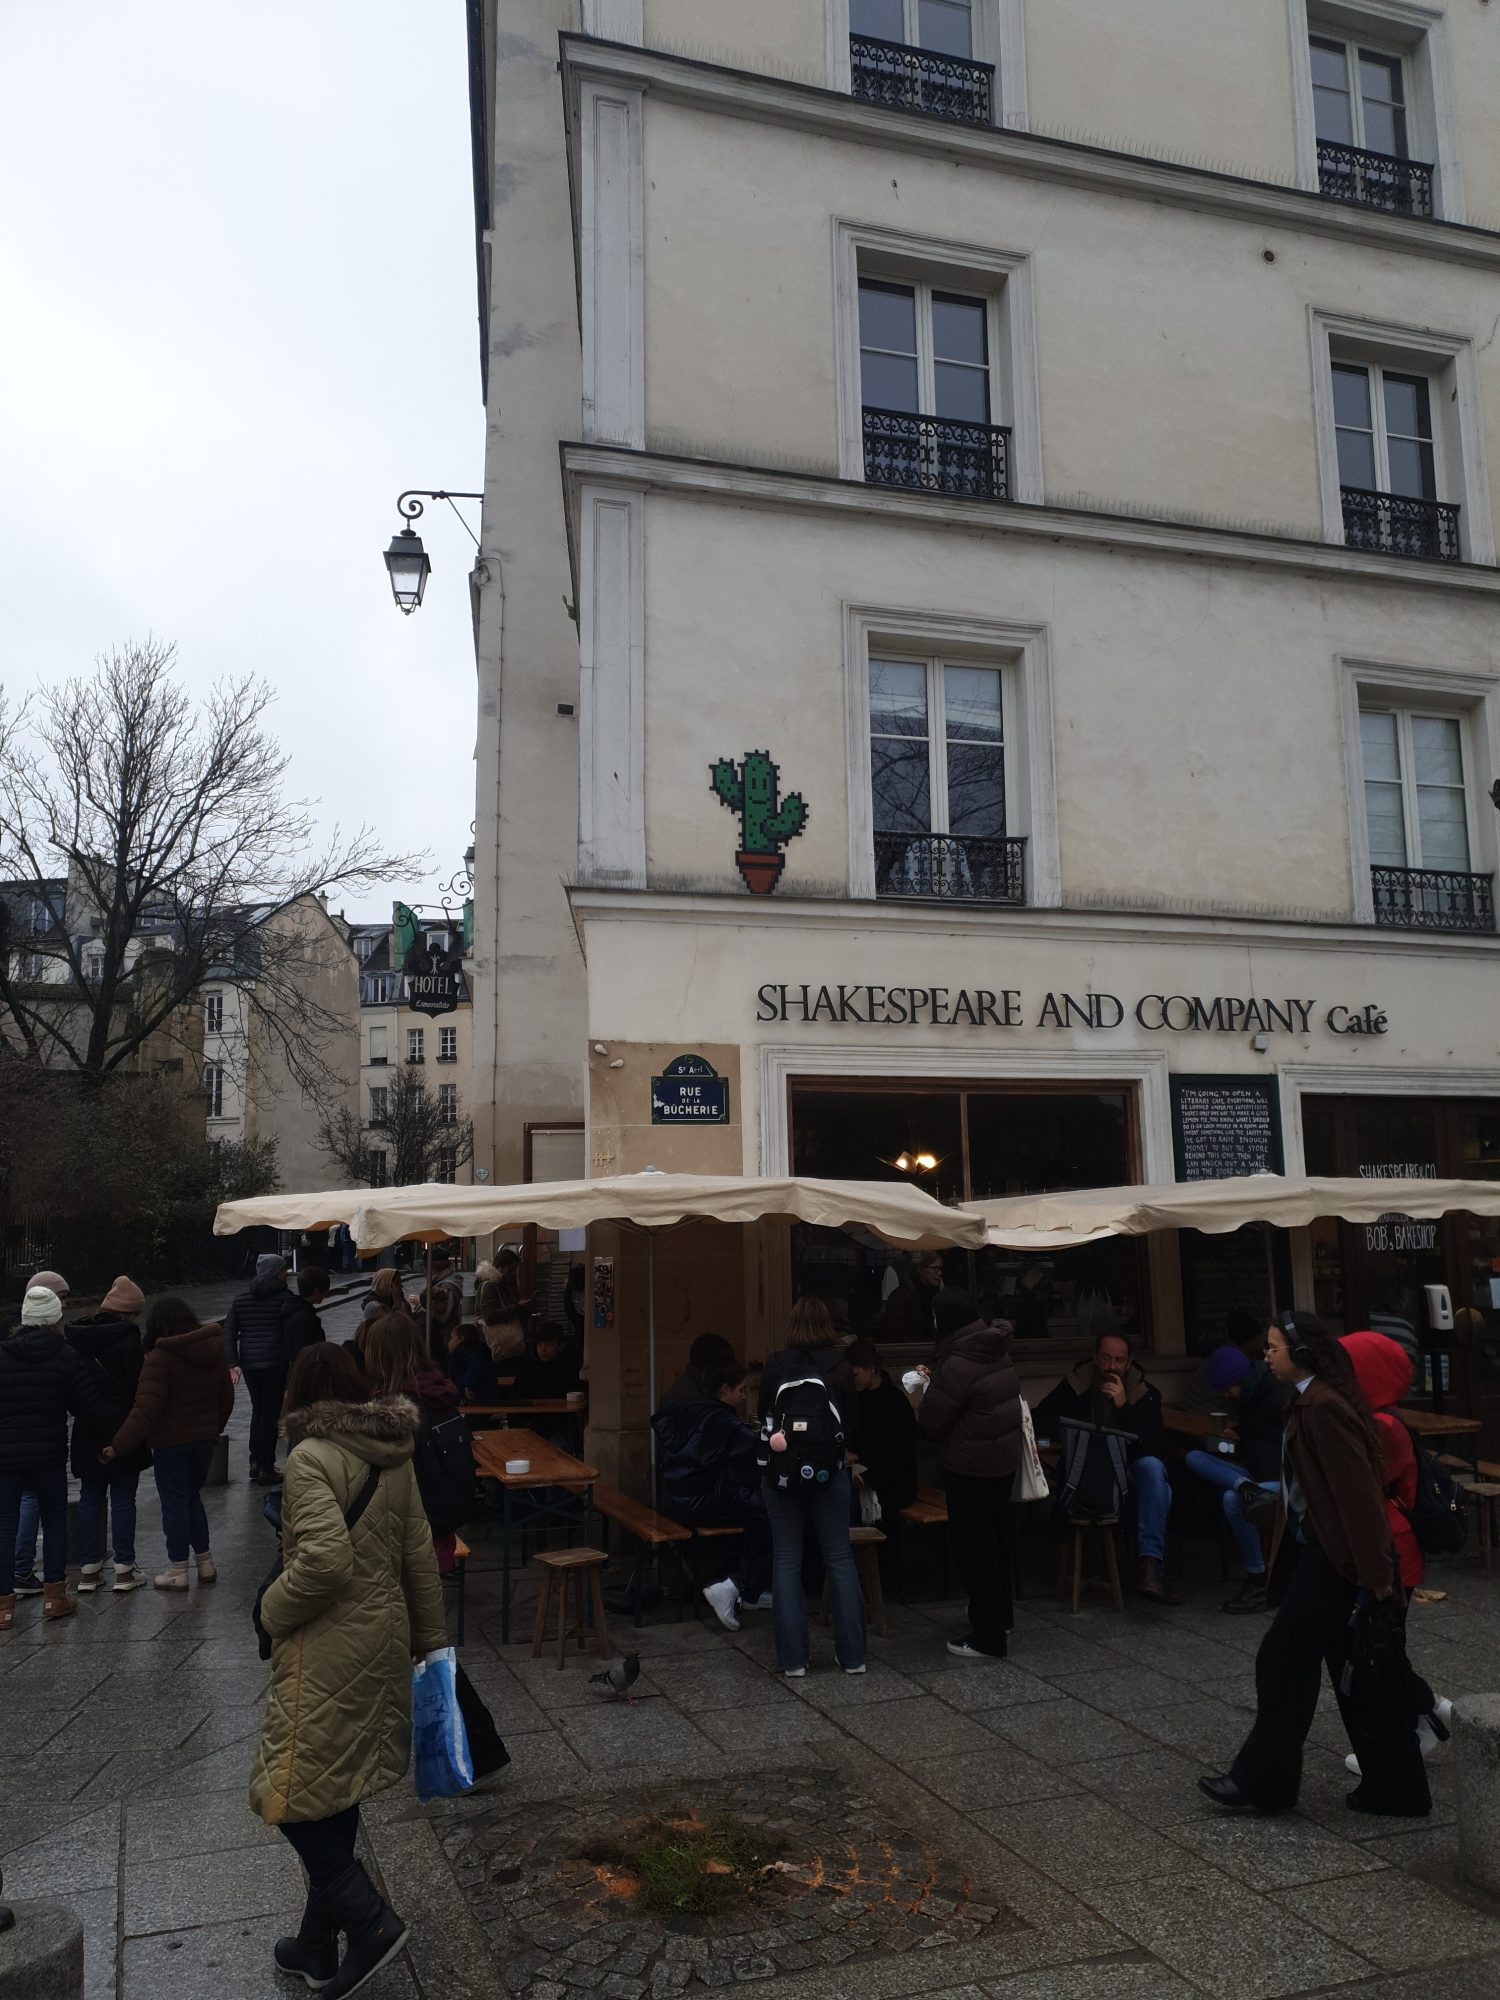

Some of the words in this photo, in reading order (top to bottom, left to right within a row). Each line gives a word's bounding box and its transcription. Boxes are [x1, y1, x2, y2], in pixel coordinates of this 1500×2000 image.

[414, 976, 453, 995] HOTEL
[415, 999, 451, 1009] Esmeralda
[756, 983, 1024, 1027] SHAKESPEARE
[1035, 992, 1124, 1030] AND
[1135, 994, 1317, 1034] COMPANY
[1325, 1004, 1389, 1035] Café
[679, 1087, 702, 1097] RUE
[1198, 1090, 1219, 1098] GOING
[663, 1103, 718, 1115] BÛCHERIE
[1195, 1136, 1207, 1144] GOT
[1208, 1136, 1217, 1144] TO
[1218, 1136, 1234, 1144] RAISE
[1239, 1136, 1268, 1144] ENOUGH
[1186, 1144, 1208, 1153] MONEY
[1212, 1144, 1219, 1153] TO
[1221, 1144, 1233, 1153] BUY
[1234, 1144, 1244, 1153] THE
[1247, 1144, 1269, 1153] STORE
[1184, 1152, 1206, 1160] BEHIND
[1207, 1152, 1220, 1160] THIS
[1236, 1152, 1251, 1160] THEN
[1255, 1152, 1266, 1160] WE
[1186, 1160, 1199, 1169] CAN
[1201, 1160, 1223, 1169] KNOCK
[1224, 1160, 1238, 1169] OUT
[1241, 1160, 1246, 1169] A
[1186, 1168, 1200, 1176] AND
[1201, 1168, 1212, 1176] THE
[1394, 1224, 1437, 1251] BAKESHOP
